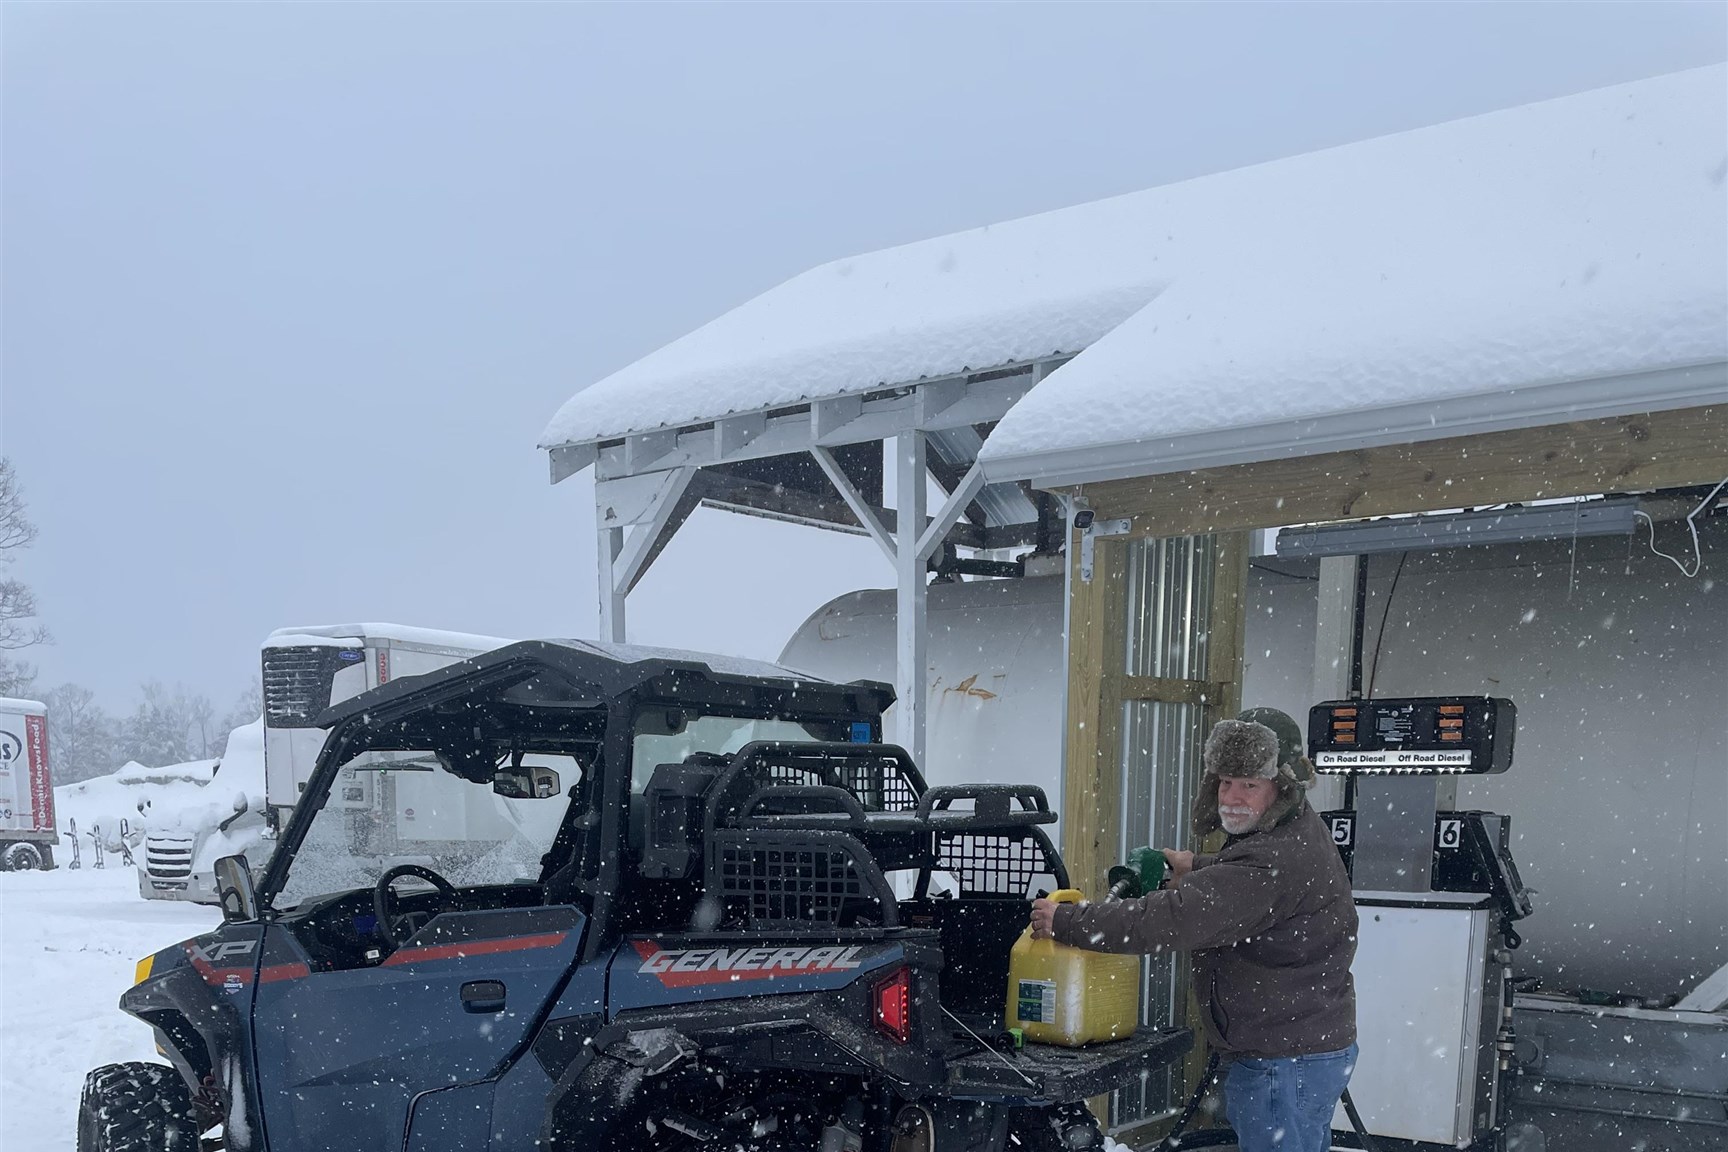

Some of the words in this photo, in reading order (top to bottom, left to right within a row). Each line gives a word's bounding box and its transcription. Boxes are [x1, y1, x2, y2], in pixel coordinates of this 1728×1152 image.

[1323, 755, 1335, 763] On
[1337, 754, 1358, 763] Road
[1360, 753, 1386, 763] Diesel
[1398, 754, 1412, 762] Off
[1413, 753, 1436, 762] Road
[1437, 753, 1465, 762] Diesel
[1334, 820, 1349, 842] 5
[1442, 822, 1458, 845] 6
[189, 940, 258, 962] XP
[637, 946, 863, 974] GENERAL
